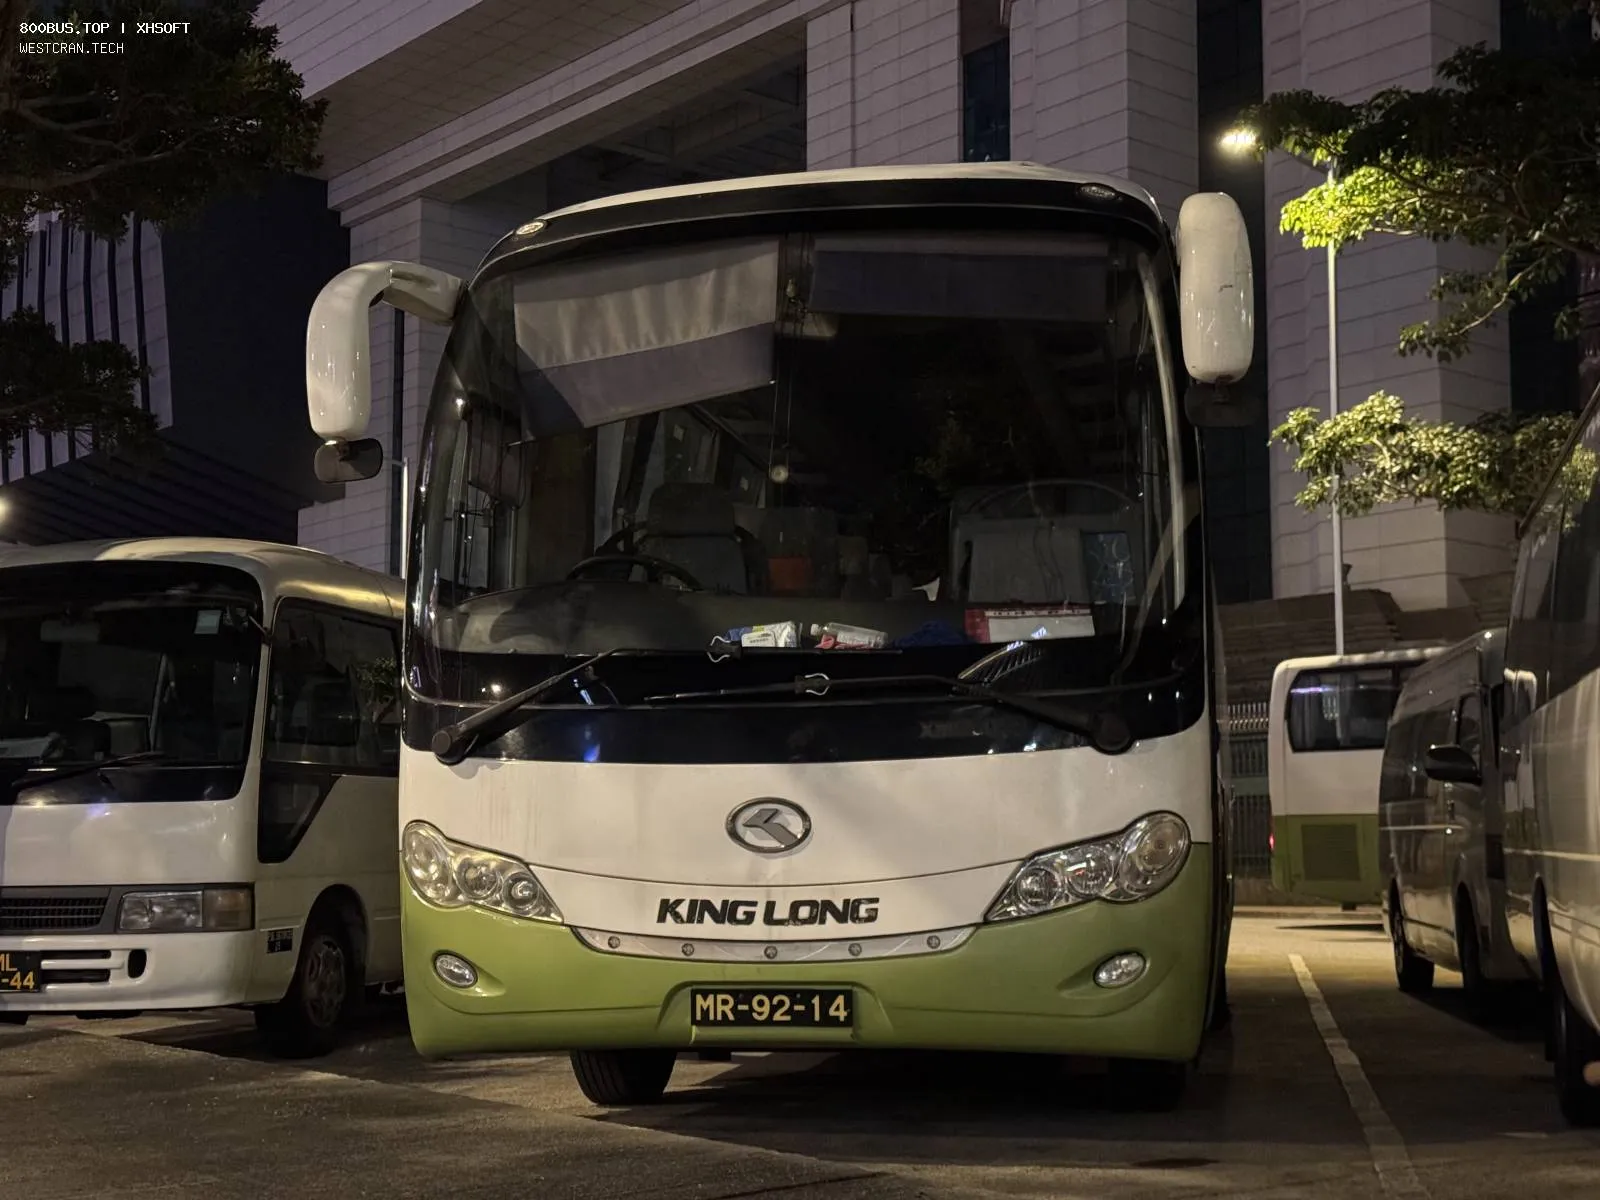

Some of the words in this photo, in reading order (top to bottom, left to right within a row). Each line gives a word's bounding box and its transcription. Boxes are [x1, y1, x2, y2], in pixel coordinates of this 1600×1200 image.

[656, 898, 758, 925] KING
[763, 897, 880, 926] LONG
[695, 994, 848, 1022] MR-92-14
